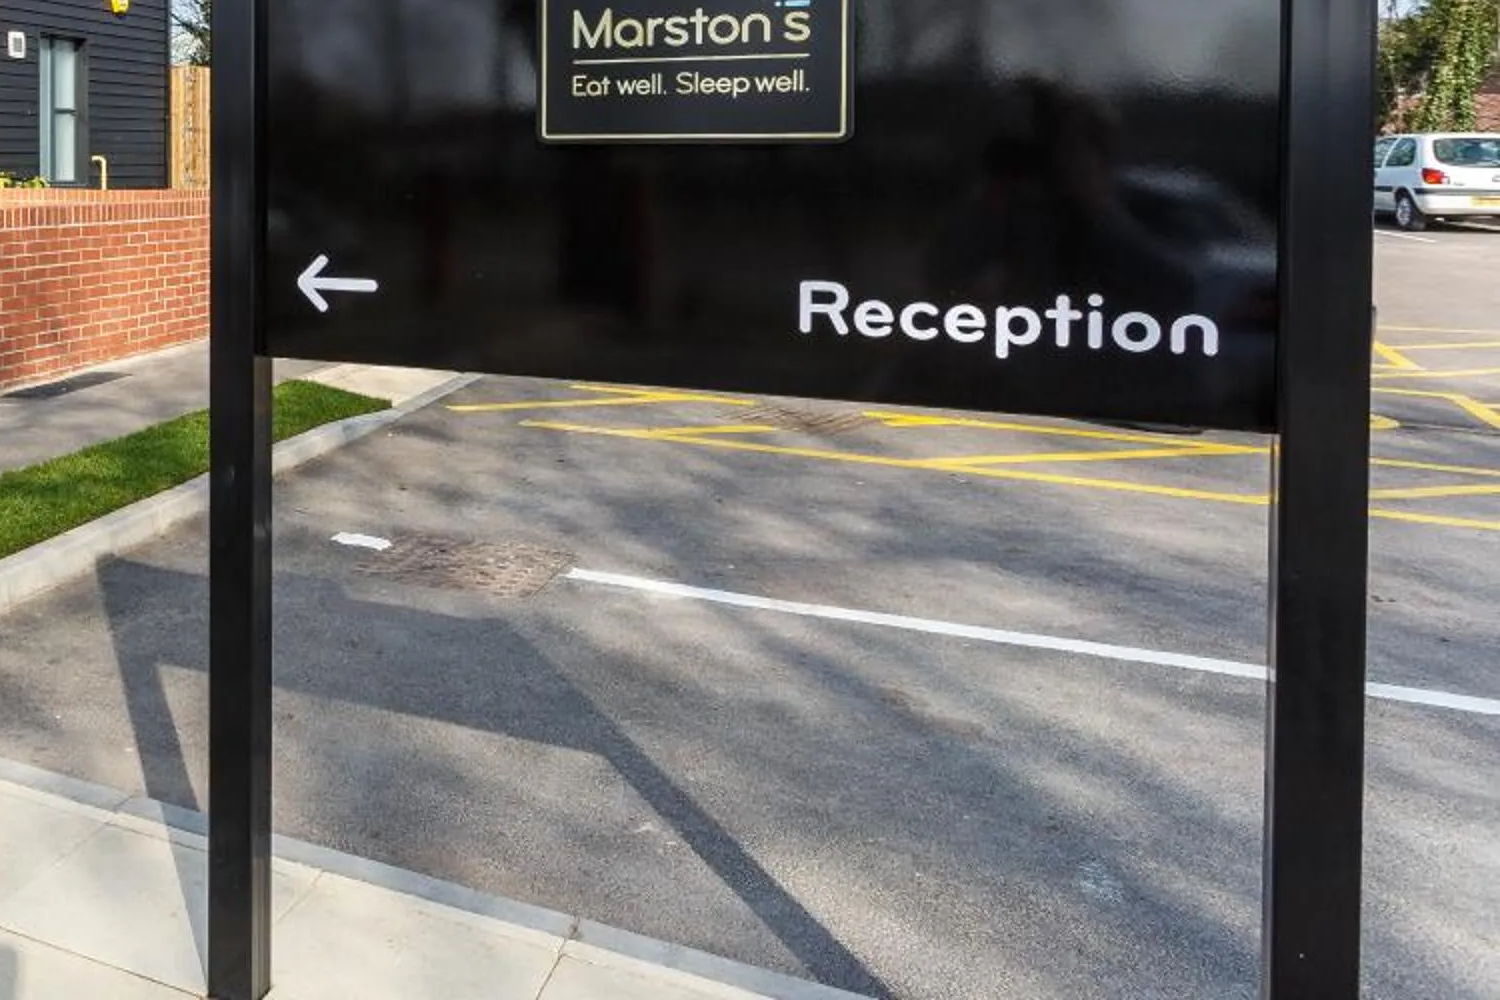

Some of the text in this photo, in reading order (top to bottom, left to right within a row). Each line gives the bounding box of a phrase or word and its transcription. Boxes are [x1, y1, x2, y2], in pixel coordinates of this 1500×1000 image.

[572, 68, 811, 99] Eat well. Sleep well.
[799, 280, 1219, 359] Reception
